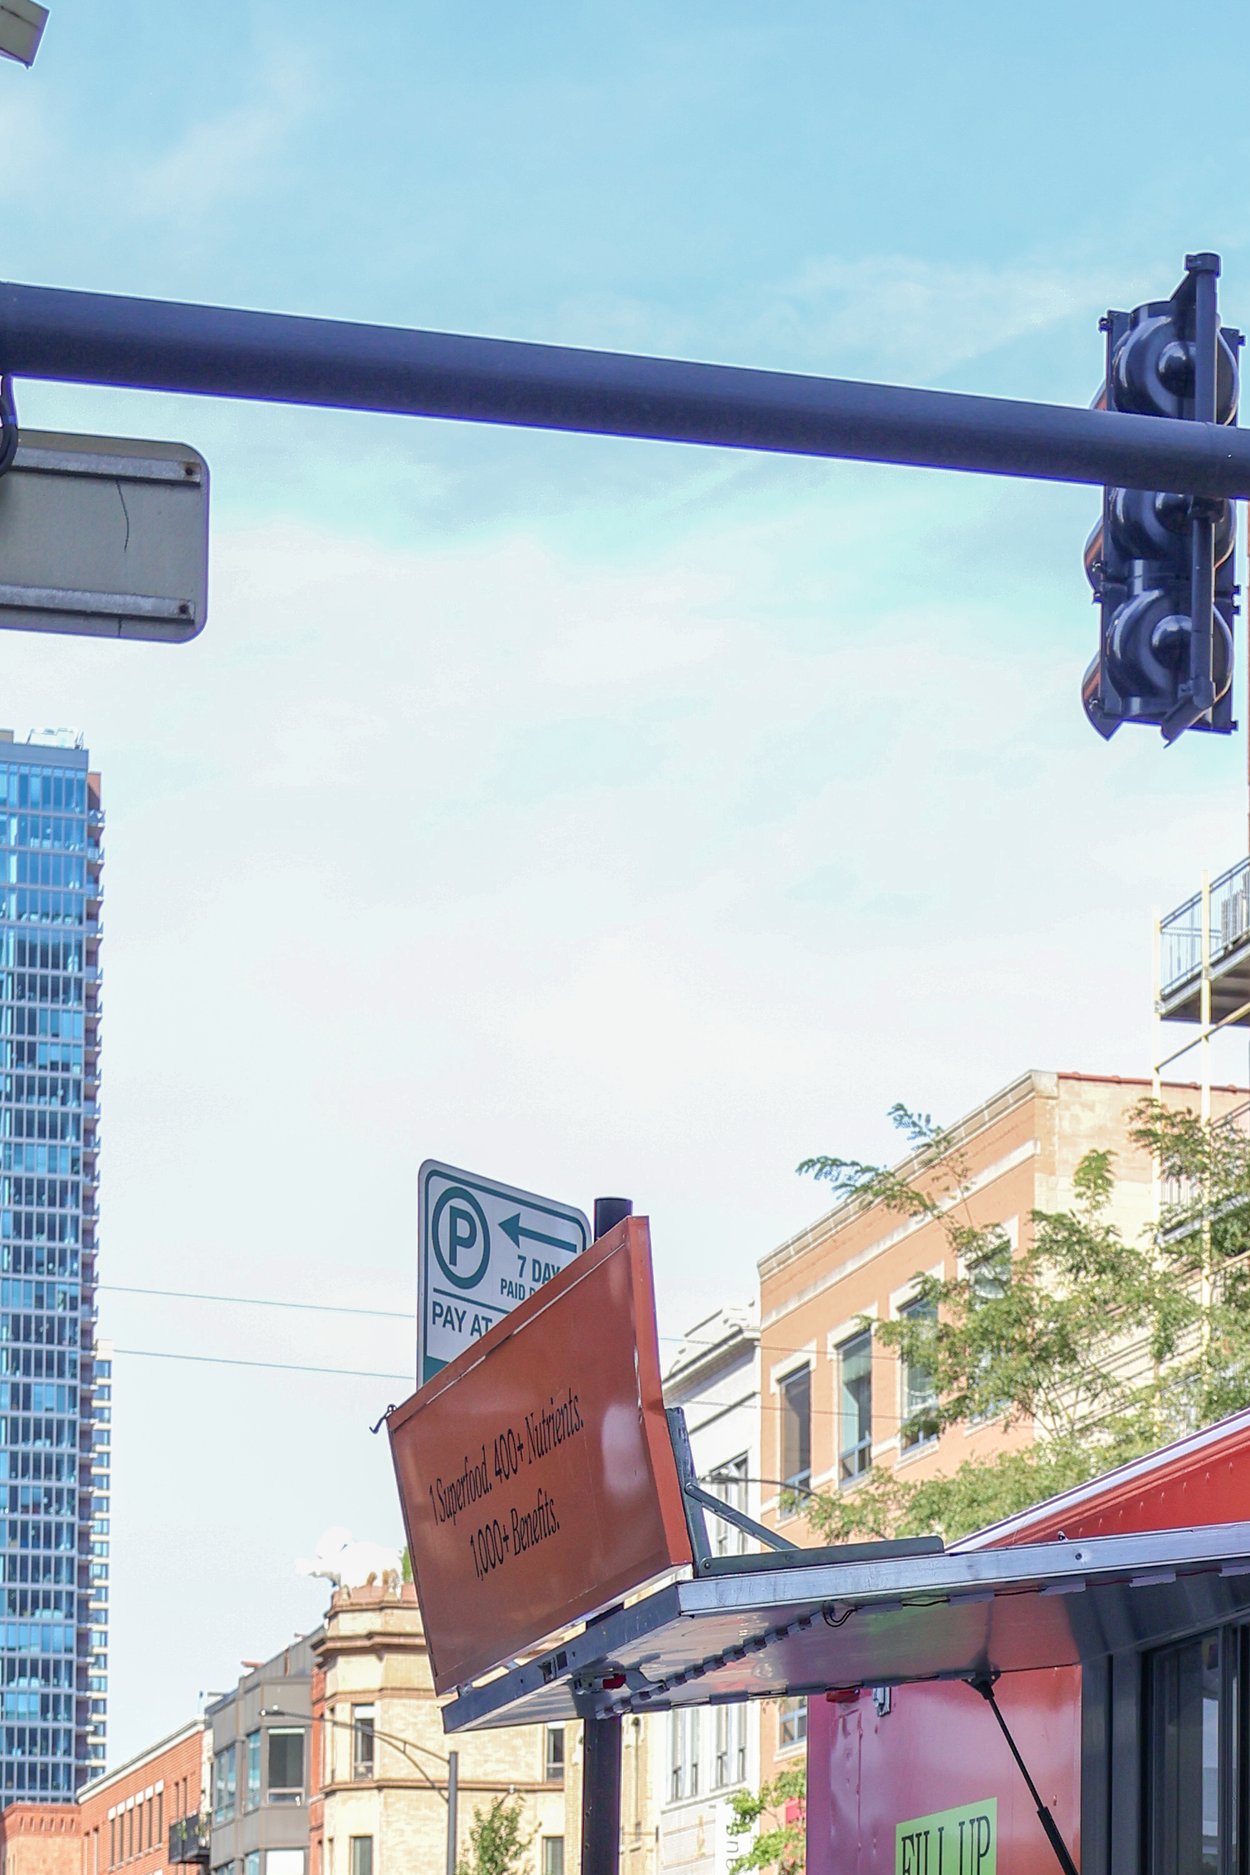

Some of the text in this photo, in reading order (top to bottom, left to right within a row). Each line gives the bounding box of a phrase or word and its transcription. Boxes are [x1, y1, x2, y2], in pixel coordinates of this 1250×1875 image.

[449, 1205, 477, 1267] P
[500, 1278, 526, 1300] PAID
[517, 1254, 527, 1278] 7
[432, 1301, 493, 1337] PAY AT
[428, 1387, 584, 1526] 1 Superfood. 400+ Nutrients.
[469, 1488, 560, 1581] 1,000+ Benefits.
